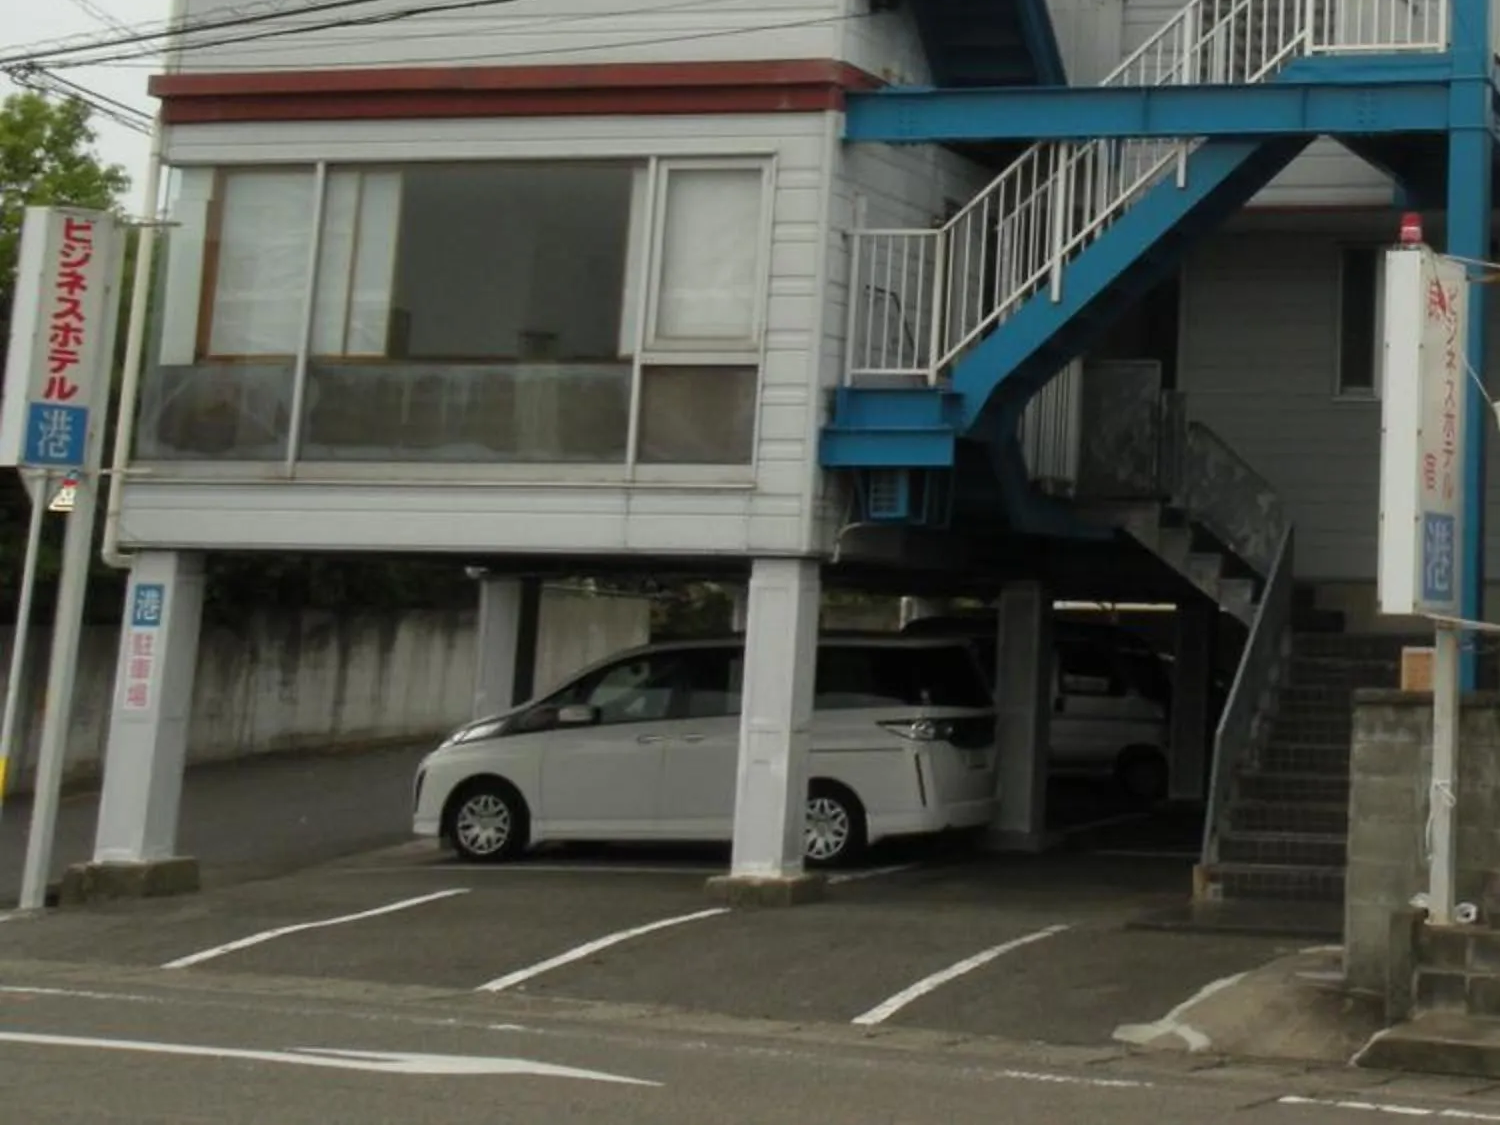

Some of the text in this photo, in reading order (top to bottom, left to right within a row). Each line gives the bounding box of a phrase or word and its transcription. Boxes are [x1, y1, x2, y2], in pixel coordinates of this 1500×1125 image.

[37, 218, 95, 459] ビジネスホテル 港
